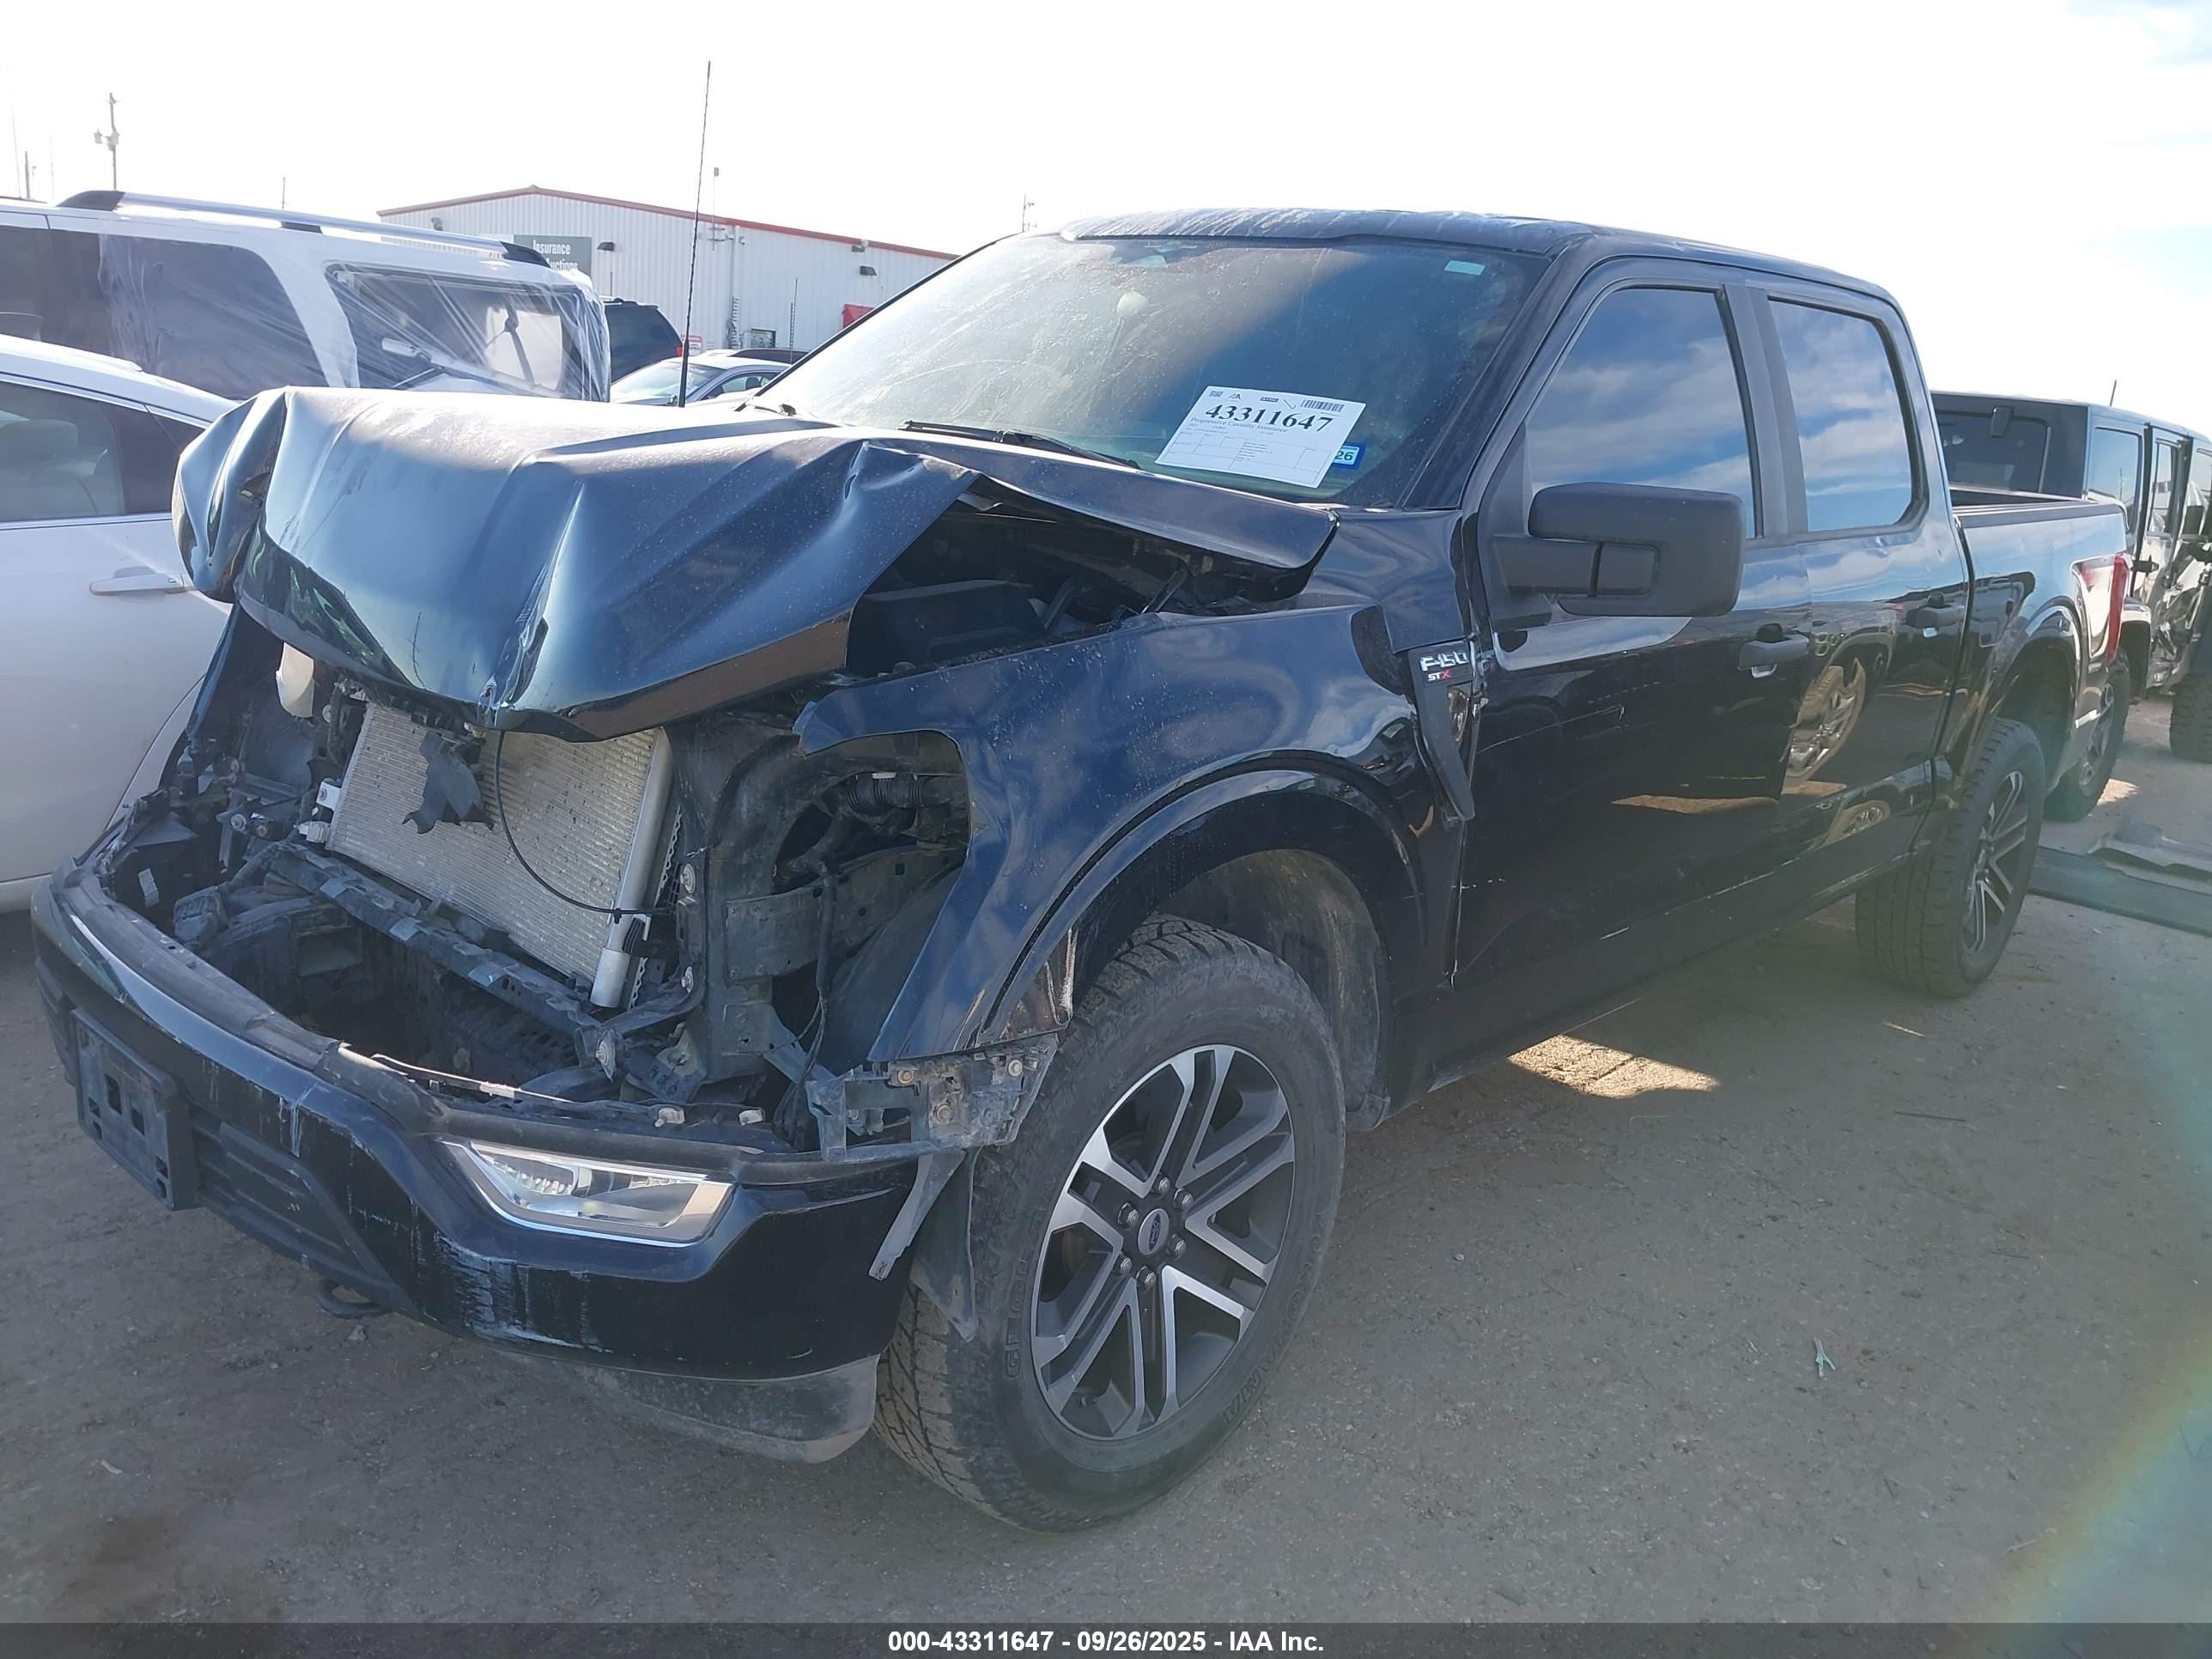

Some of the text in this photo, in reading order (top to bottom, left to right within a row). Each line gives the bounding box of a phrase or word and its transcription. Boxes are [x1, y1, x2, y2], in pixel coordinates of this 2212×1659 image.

[532, 240, 571, 255] Insurance
[1190, 417, 1227, 427] Progressive
[1228, 421, 1255, 429] Casualty
[1256, 423, 1289, 434] Insurance
[1205, 404, 1334, 433] 43311647
[1334, 450, 1354, 461] 26
[1419, 651, 1470, 672] F-150
[1428, 669, 1451, 682] STX
